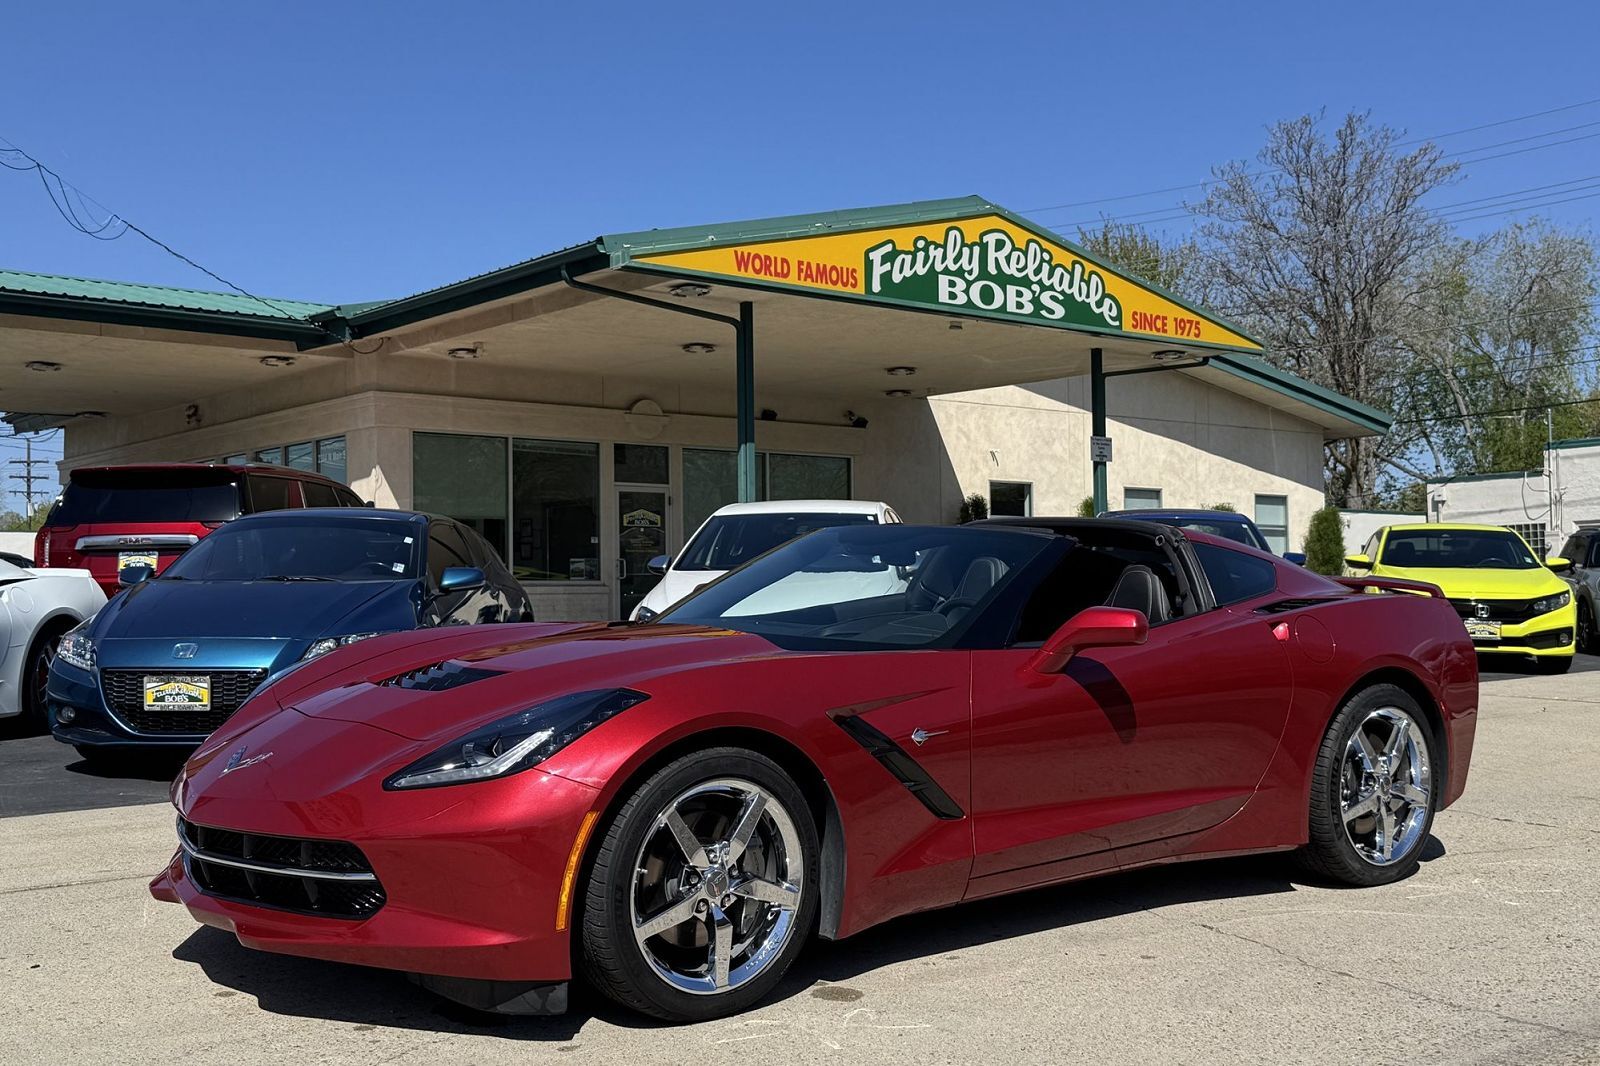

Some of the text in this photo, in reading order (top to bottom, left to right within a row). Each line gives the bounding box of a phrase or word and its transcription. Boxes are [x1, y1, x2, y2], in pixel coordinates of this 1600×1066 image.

[733, 249, 858, 289] WORLD FAMOUS
[869, 229, 1120, 326] Fairly Reliable
[938, 274, 1065, 320] BOB'S
[1131, 310, 1201, 338] SINCE 1975
